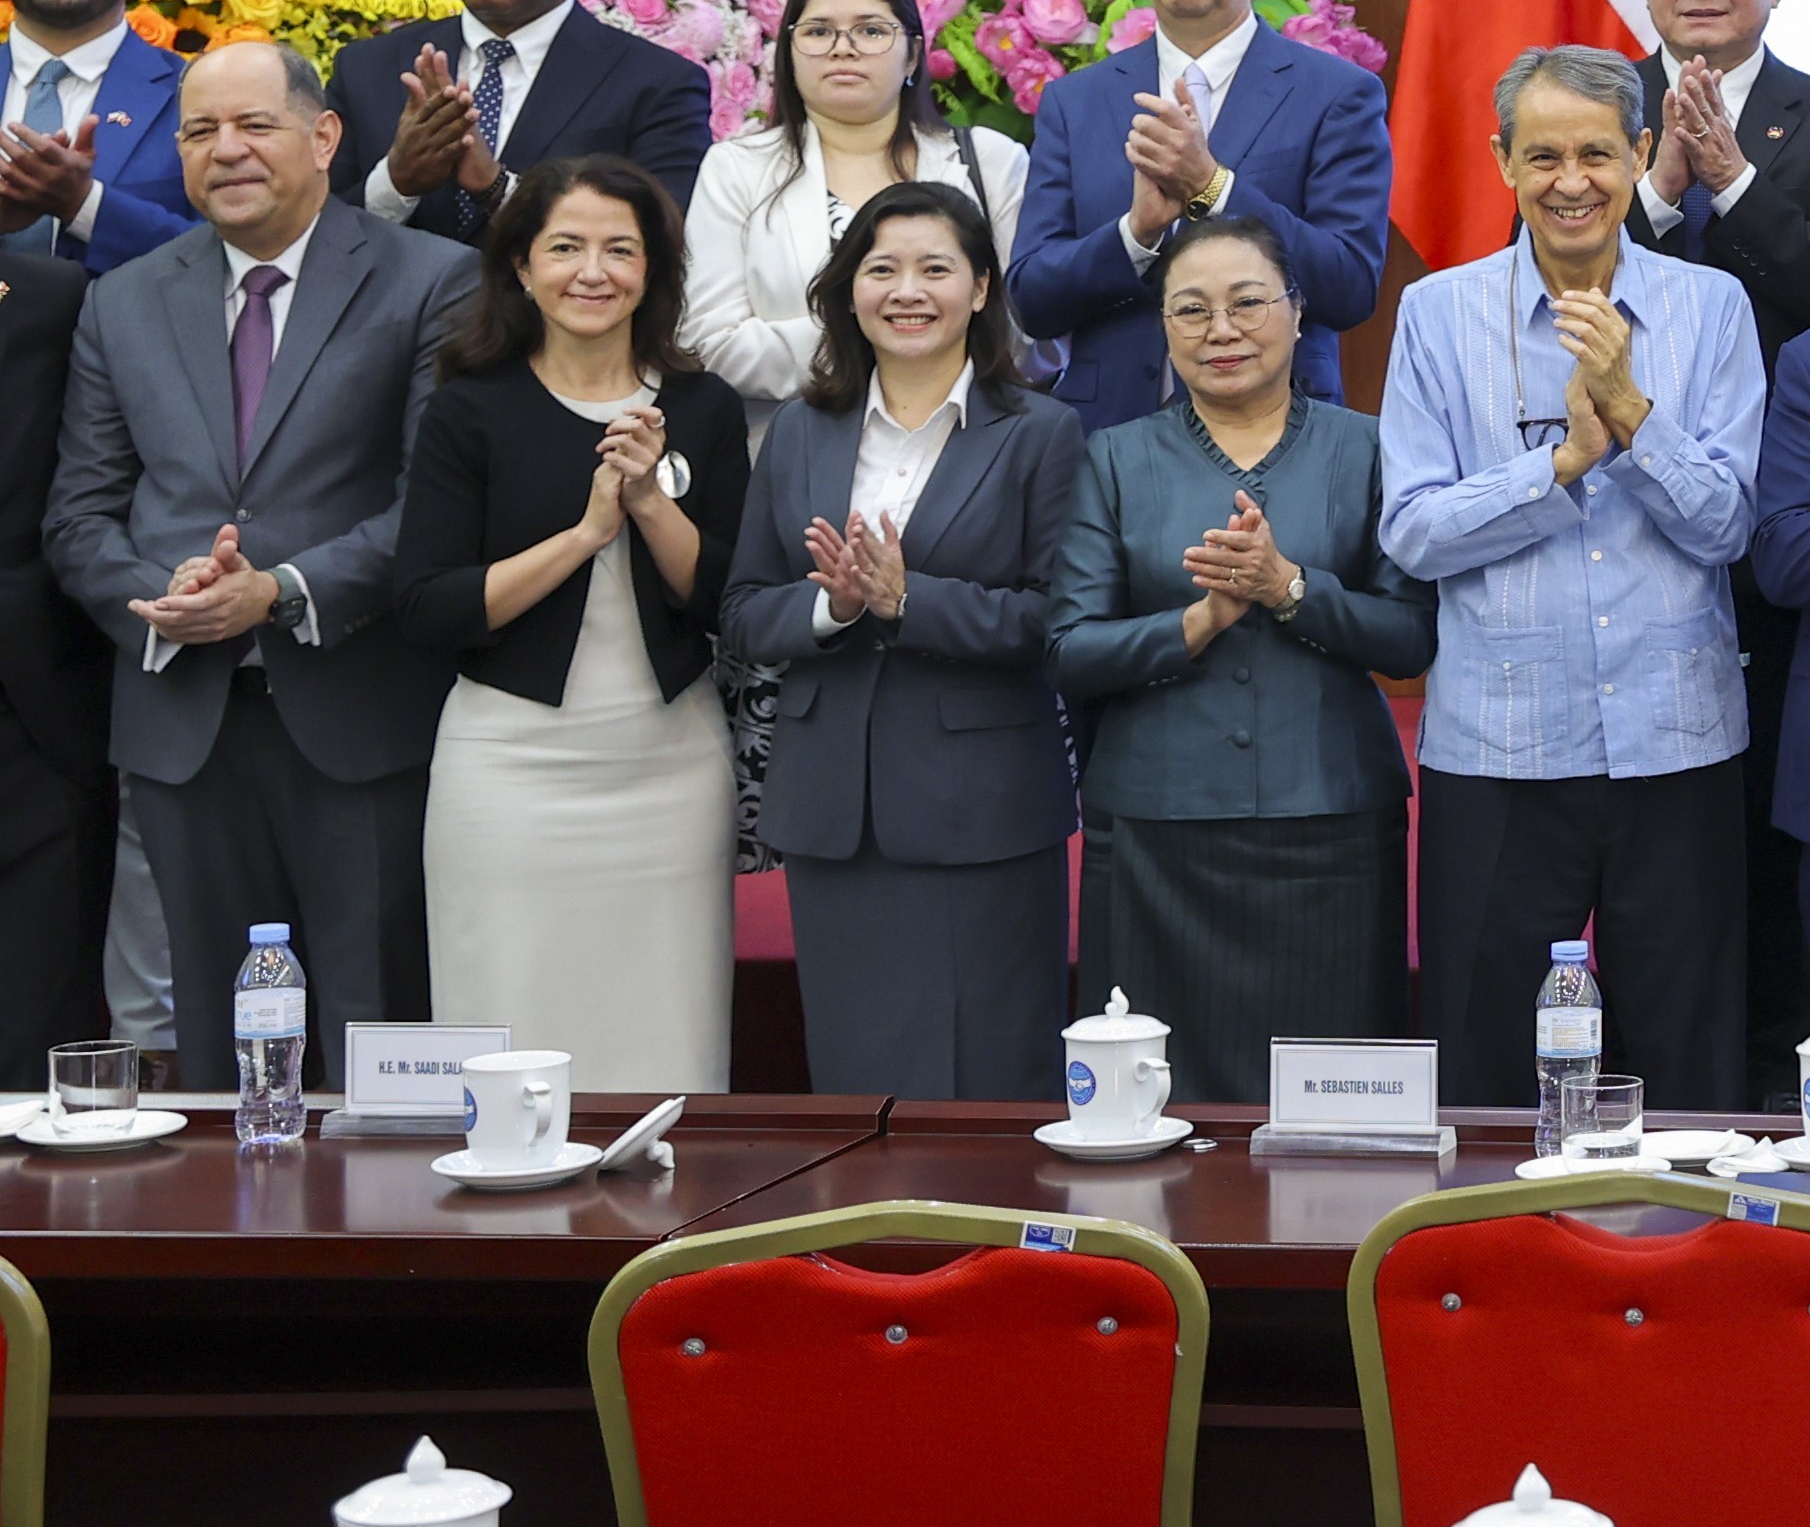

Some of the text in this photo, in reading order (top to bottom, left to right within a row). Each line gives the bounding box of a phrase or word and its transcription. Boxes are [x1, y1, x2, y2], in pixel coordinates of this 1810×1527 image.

[378, 1061, 463, 1075] H.E. Mr. SAADI SALA
[1304, 1080, 1404, 1094] Mr. SEBASTIEN SALLES
